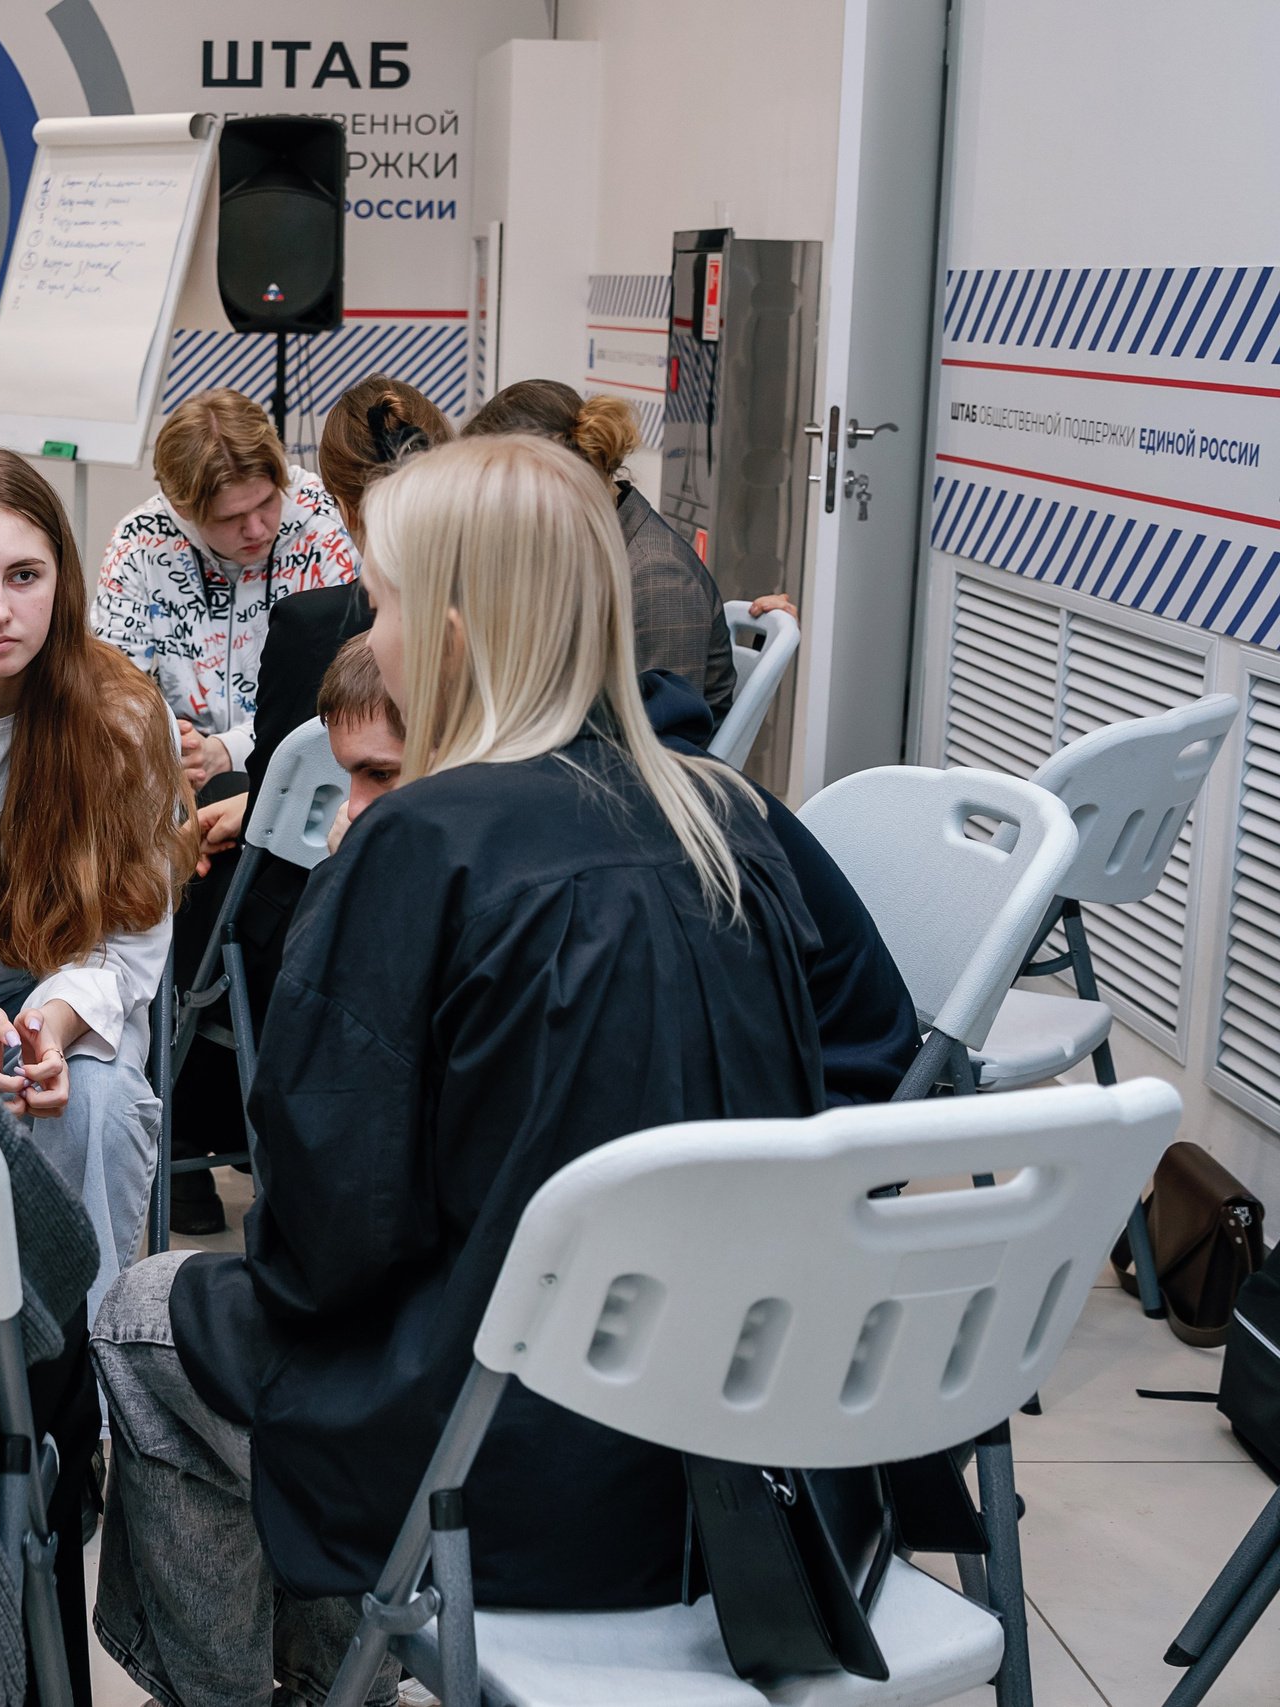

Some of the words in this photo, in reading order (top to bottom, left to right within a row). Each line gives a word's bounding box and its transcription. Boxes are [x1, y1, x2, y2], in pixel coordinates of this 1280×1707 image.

[202, 40, 411, 90] ШТАБ
[950, 401, 978, 424] ШТАБ
[979, 404, 1062, 437] ОБЩЕСТВЕННОЙ
[1063, 416, 1136, 449] ПОДДЕРЖКИ
[1138, 427, 1196, 458] ЕДИНОЙ
[1199, 436, 1261, 468] РОССИИ
